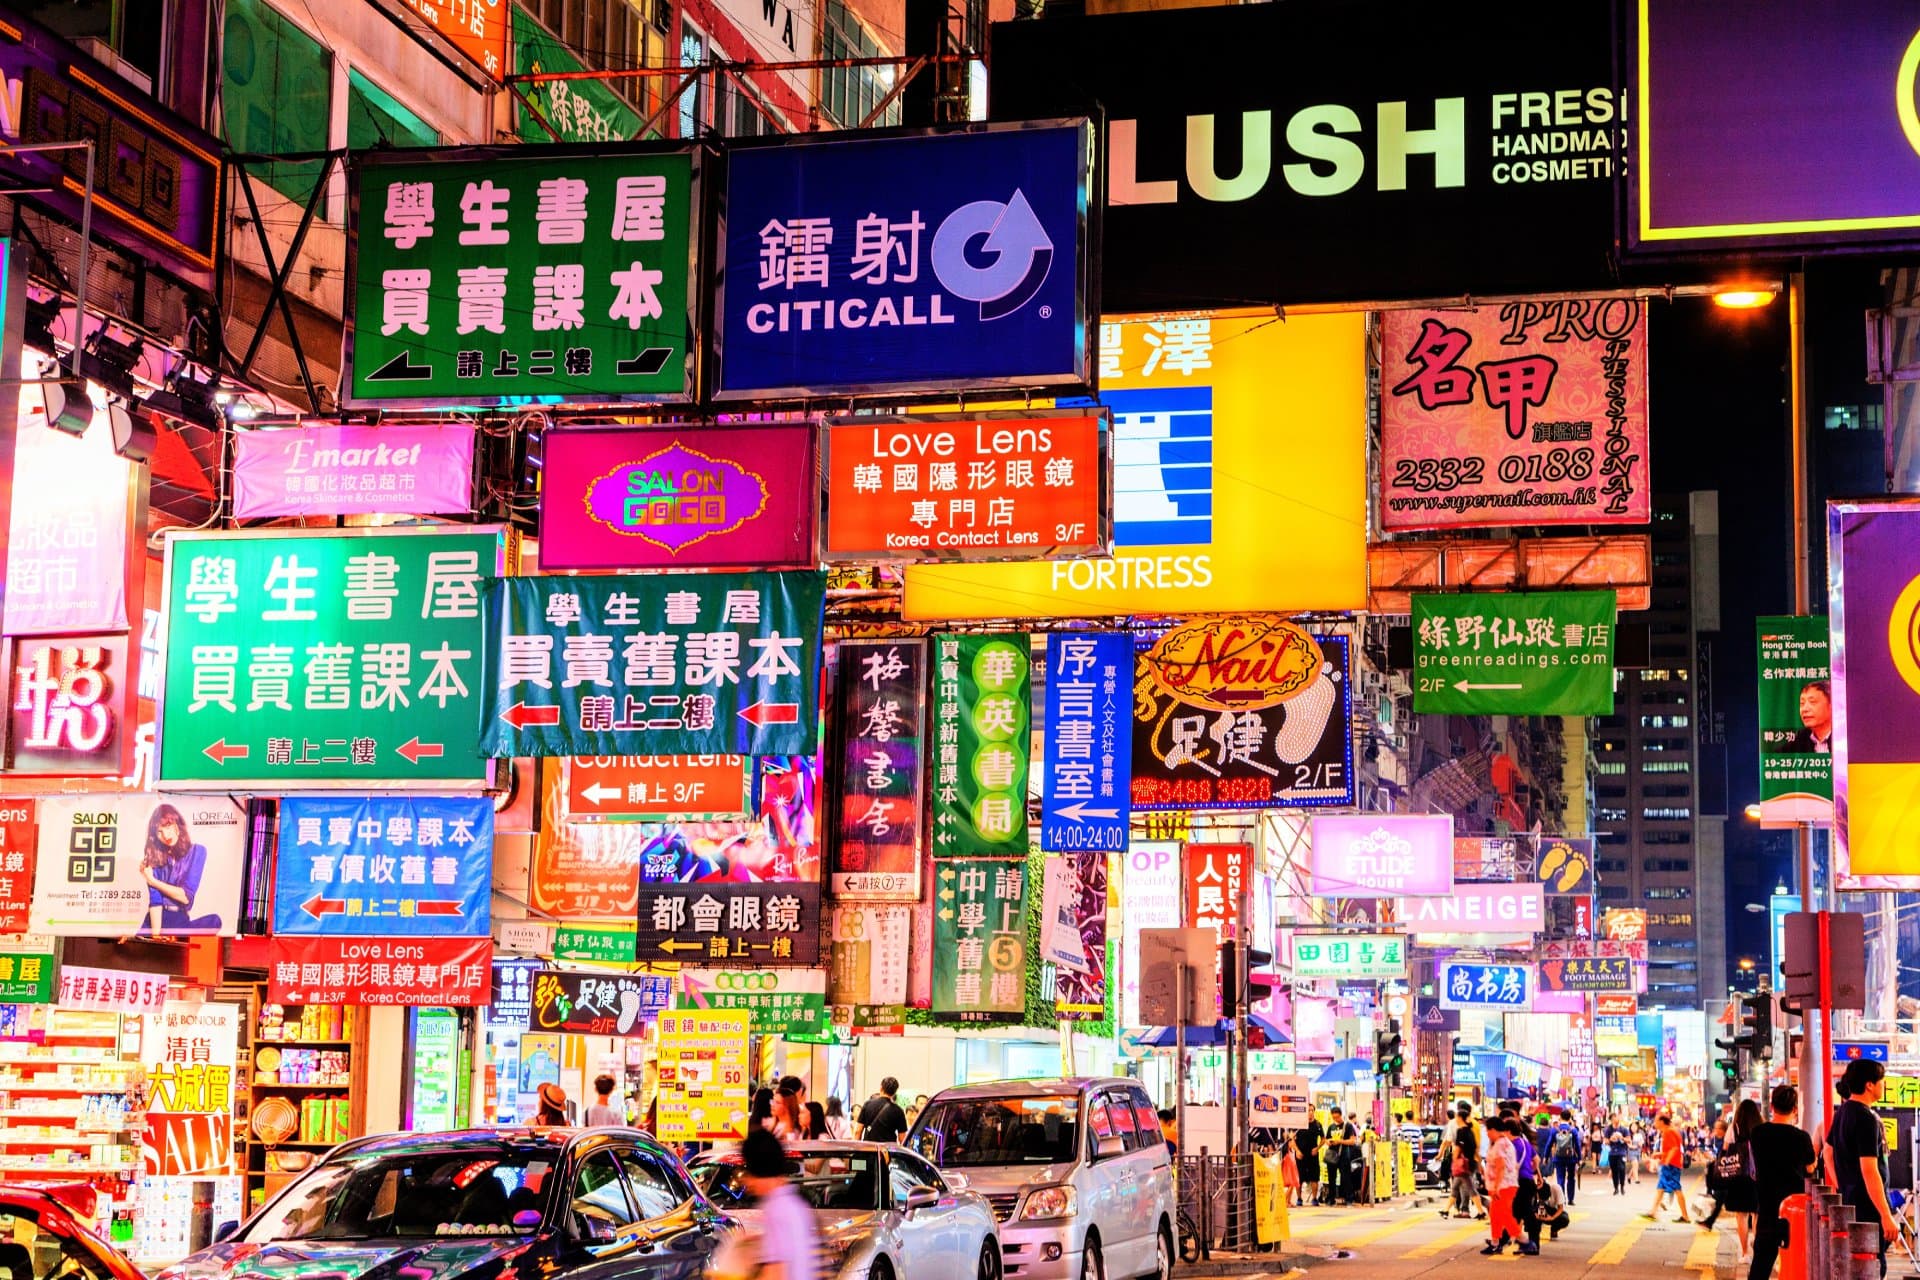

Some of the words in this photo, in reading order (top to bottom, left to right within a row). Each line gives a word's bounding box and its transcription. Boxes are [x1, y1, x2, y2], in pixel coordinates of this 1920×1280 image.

[1108, 97, 1466, 206] LUSH
[383, 175, 667, 250] 學生書屋
[758, 210, 926, 291] 鐳射
[381, 261, 664, 337] 買賣課本
[746, 294, 955, 333] CITICALL
[1500, 299, 1640, 344] PRO
[456, 348, 593, 378] 請上二樓
[1391, 318, 1558, 440] 名甲
[873, 428, 955, 458] Love
[976, 424, 1052, 455] Lens
[1532, 422, 1592, 442] 旗艦店
[284, 439, 422, 474] Emarket
[1392, 457, 1485, 491] 2332
[1498, 448, 1595, 483] 0188
[284, 474, 416, 492] 韓國化妝品超市
[627, 469, 725, 495] SALON
[853, 457, 1074, 494] 韓國隱形眼鏡
[365, 492, 415, 503] Cosmetics
[623, 496, 726, 526] GOGO
[1390, 487, 1597, 513] www.supernail.com.hk
[910, 497, 1014, 529] 專門店
[886, 532, 930, 547] Korea
[937, 531, 1000, 546] Contact
[1006, 531, 1039, 544] Lens
[1055, 524, 1085, 542] 3/F
[184, 551, 479, 624] 學生書屋
[1052, 556, 1212, 591] FORTRESS
[546, 590, 760, 627] 學生書屋
[1418, 615, 1610, 651] 綠野仙蹤書店
[1762, 641, 1783, 650] Hong
[1785, 641, 1805, 650] Kong
[1808, 640, 1827, 649] Book
[500, 631, 803, 690] 買賣舊課本
[1163, 629, 1297, 686] Nail
[1419, 653, 1608, 669] greenreadings.com
[187, 641, 472, 714] 買賣舊課本
[1420, 679, 1445, 692] 2/F
[580, 694, 714, 731] 請上二樓
[940, 641, 960, 805] 買賣中學新舊課本
[1053, 637, 1098, 799] 序言書室
[980, 649, 1016, 834] 華英書局
[1100, 665, 1117, 797] 專營人文及社會書籍
[266, 736, 376, 765] 請上二樓
[1765, 758, 1833, 767] 19-25/7/2017
[1295, 763, 1342, 787] 2/F
[627, 783, 667, 804] 請上
[673, 782, 705, 803] 3/F
[73, 813, 118, 825] SALON
[296, 817, 476, 847] 買賣中學課本
[1048, 826, 1123, 850] 14:00-24:00
[310, 855, 459, 884] 高價收舊書
[773, 848, 820, 874] Ray-Ban
[1132, 851, 1170, 871] OP
[121, 890, 141, 899] 2828
[347, 899, 415, 917] 請上二樓
[1398, 895, 1538, 920] LANEIGE
[652, 894, 801, 933] 都會眼鏡
[341, 943, 381, 959] Love
[386, 943, 424, 959] Lens
[710, 936, 793, 958] 請上一樓
[955, 867, 987, 1006] 中學舊書
[1298, 942, 1402, 964] 田園書屋
[276, 961, 484, 988] 韓國隱形眼鏡專門店
[0, 983, 37, 997] 上二樓
[360, 991, 394, 1003] Korea
[395, 992, 444, 1004] Contact
[445, 993, 471, 1004] Lens
[591, 1017, 616, 1033] 2/F
[663, 1018, 694, 1033] 眼鏡
[167, 1036, 211, 1062] 清貨
[146, 1063, 231, 1112] 大減價
[725, 1071, 740, 1084] 50
[142, 1114, 231, 1176] SALE
